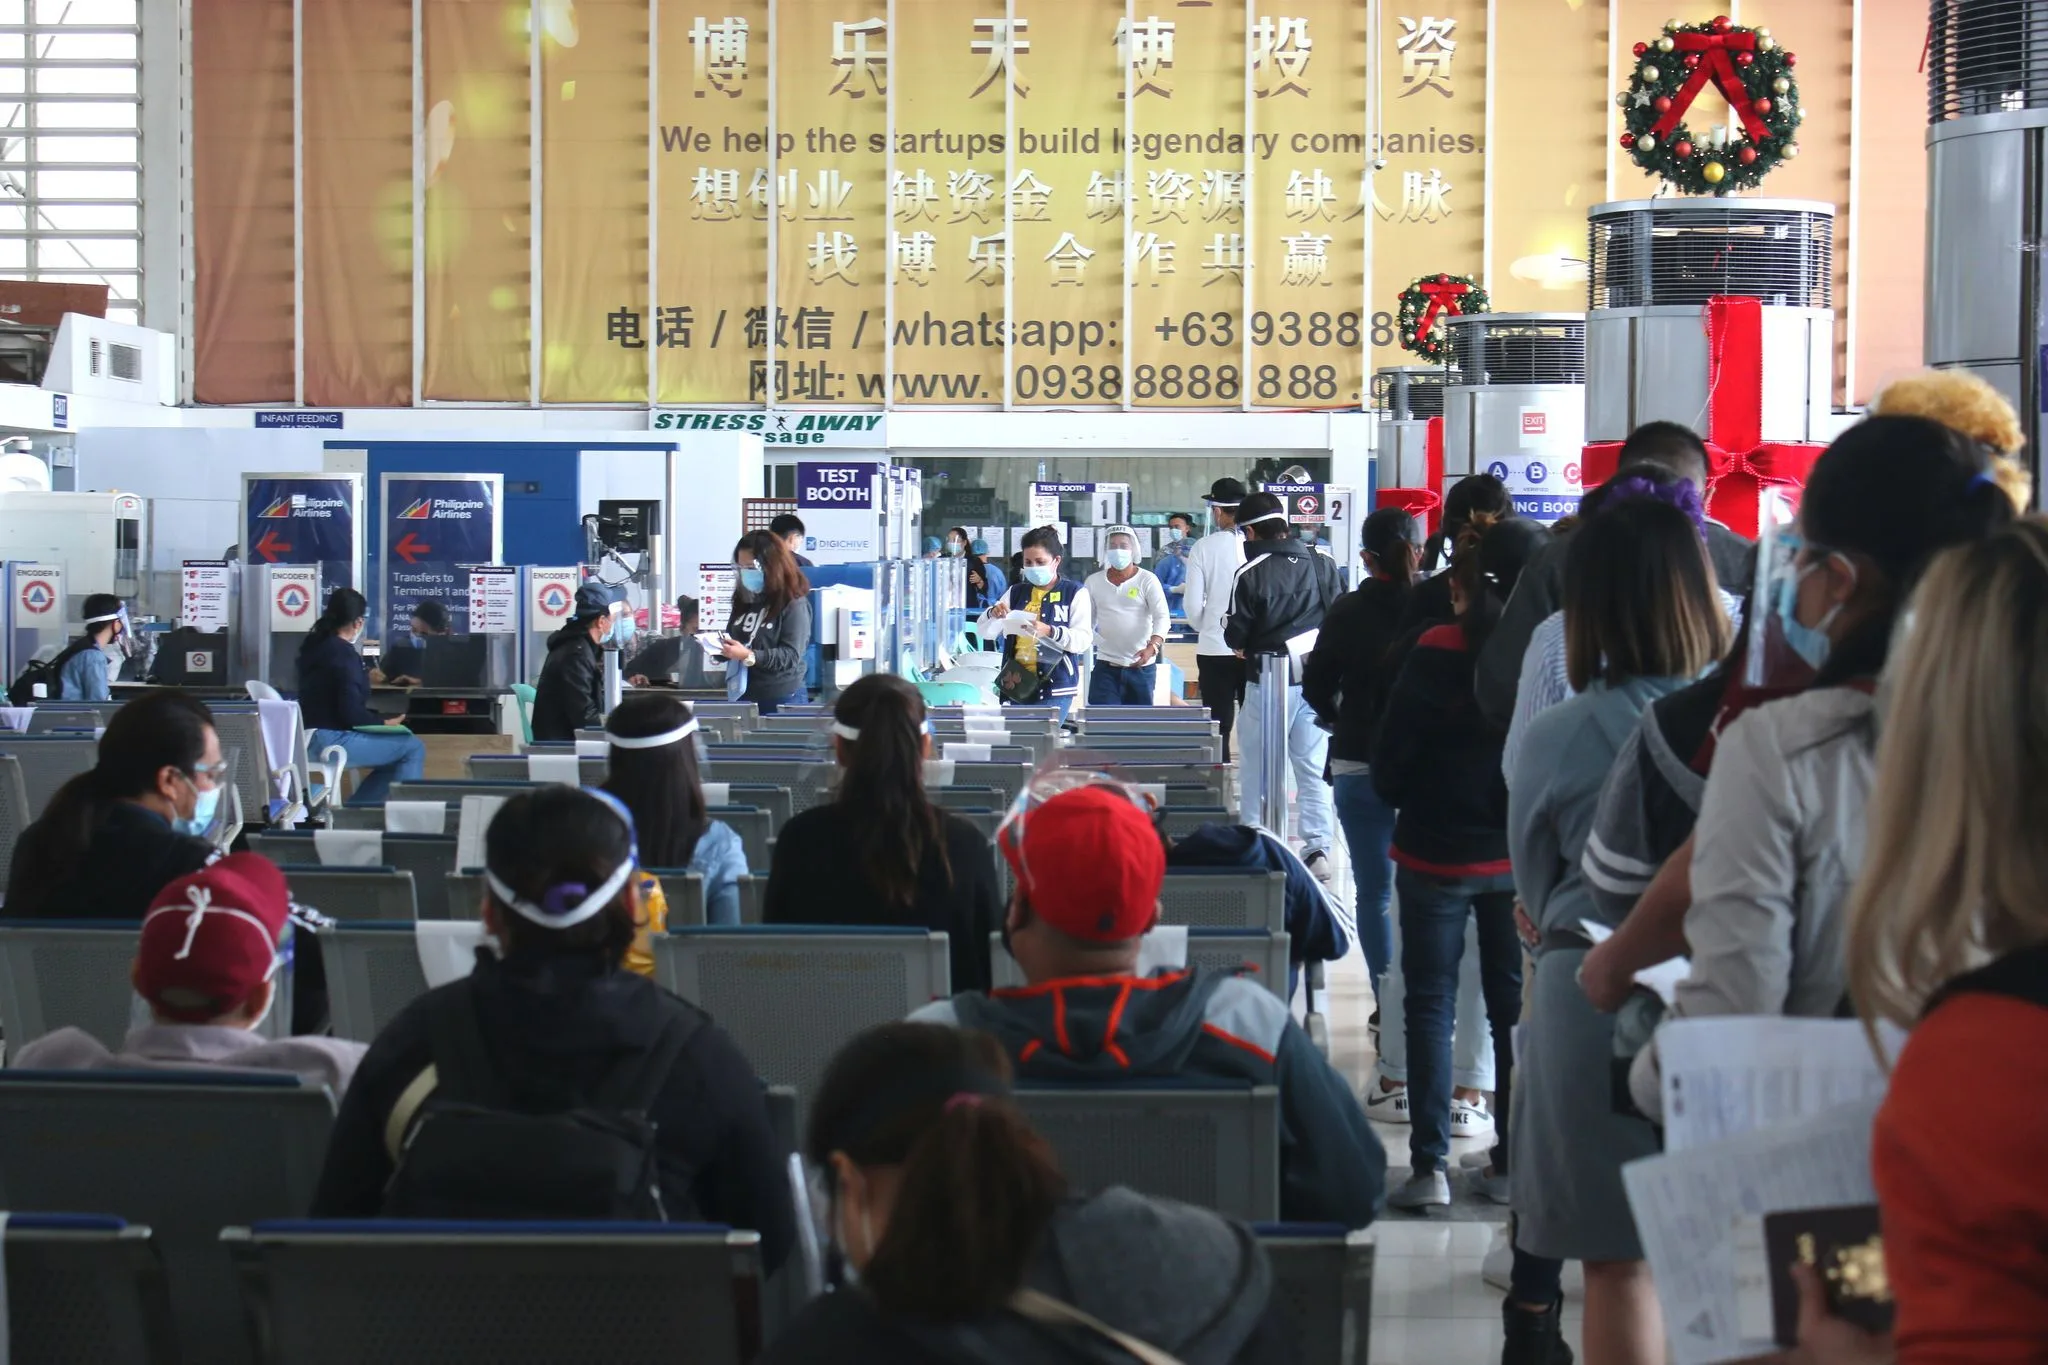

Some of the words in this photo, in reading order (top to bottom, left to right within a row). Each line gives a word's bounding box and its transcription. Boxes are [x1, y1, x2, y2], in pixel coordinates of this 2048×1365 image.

[660, 126, 711, 152] We
[724, 126, 795, 160] help
[806, 127, 856, 153] the
[1018, 127, 1099, 153] build
[1113, 127, 1280, 160] legendary
[608, 306, 694, 349] 电话
[744, 306, 835, 350] 微信
[261, 414, 295, 423] INFANT
[296, 414, 338, 423] FEEDING
[654, 413, 767, 430] STRESS
[795, 414, 883, 431] AWAY
[1524, 416, 1545, 425] EXIT
[751, 432, 825, 446] sage
[816, 469, 859, 483] TEST
[1531, 466, 1543, 479] B
[1567, 467, 1579, 480] C
[806, 487, 870, 501] BOOTH
[1268, 485, 1286, 493] TEST
[1287, 485, 1315, 493] BOOTH
[434, 499, 484, 510] Philippine
[1101, 499, 1108, 519] 1
[1542, 502, 1580, 513] BOOT
[293, 509, 332, 518] Airlines
[432, 510, 472, 519] Airlines
[1331, 500, 1343, 521] 2
[819, 540, 870, 548] DIGICHIVE
[17, 569, 54, 577] ENCODER
[393, 572, 440, 583] Transfers
[444, 573, 454, 583] to
[533, 572, 569, 580] ENCODER
[393, 586, 444, 596] Terminals
[393, 604, 406, 612] For
[1054, 605, 1069, 622] N
[1395, 1098, 1407, 1110] NI
[1451, 1112, 1468, 1124] IKE
